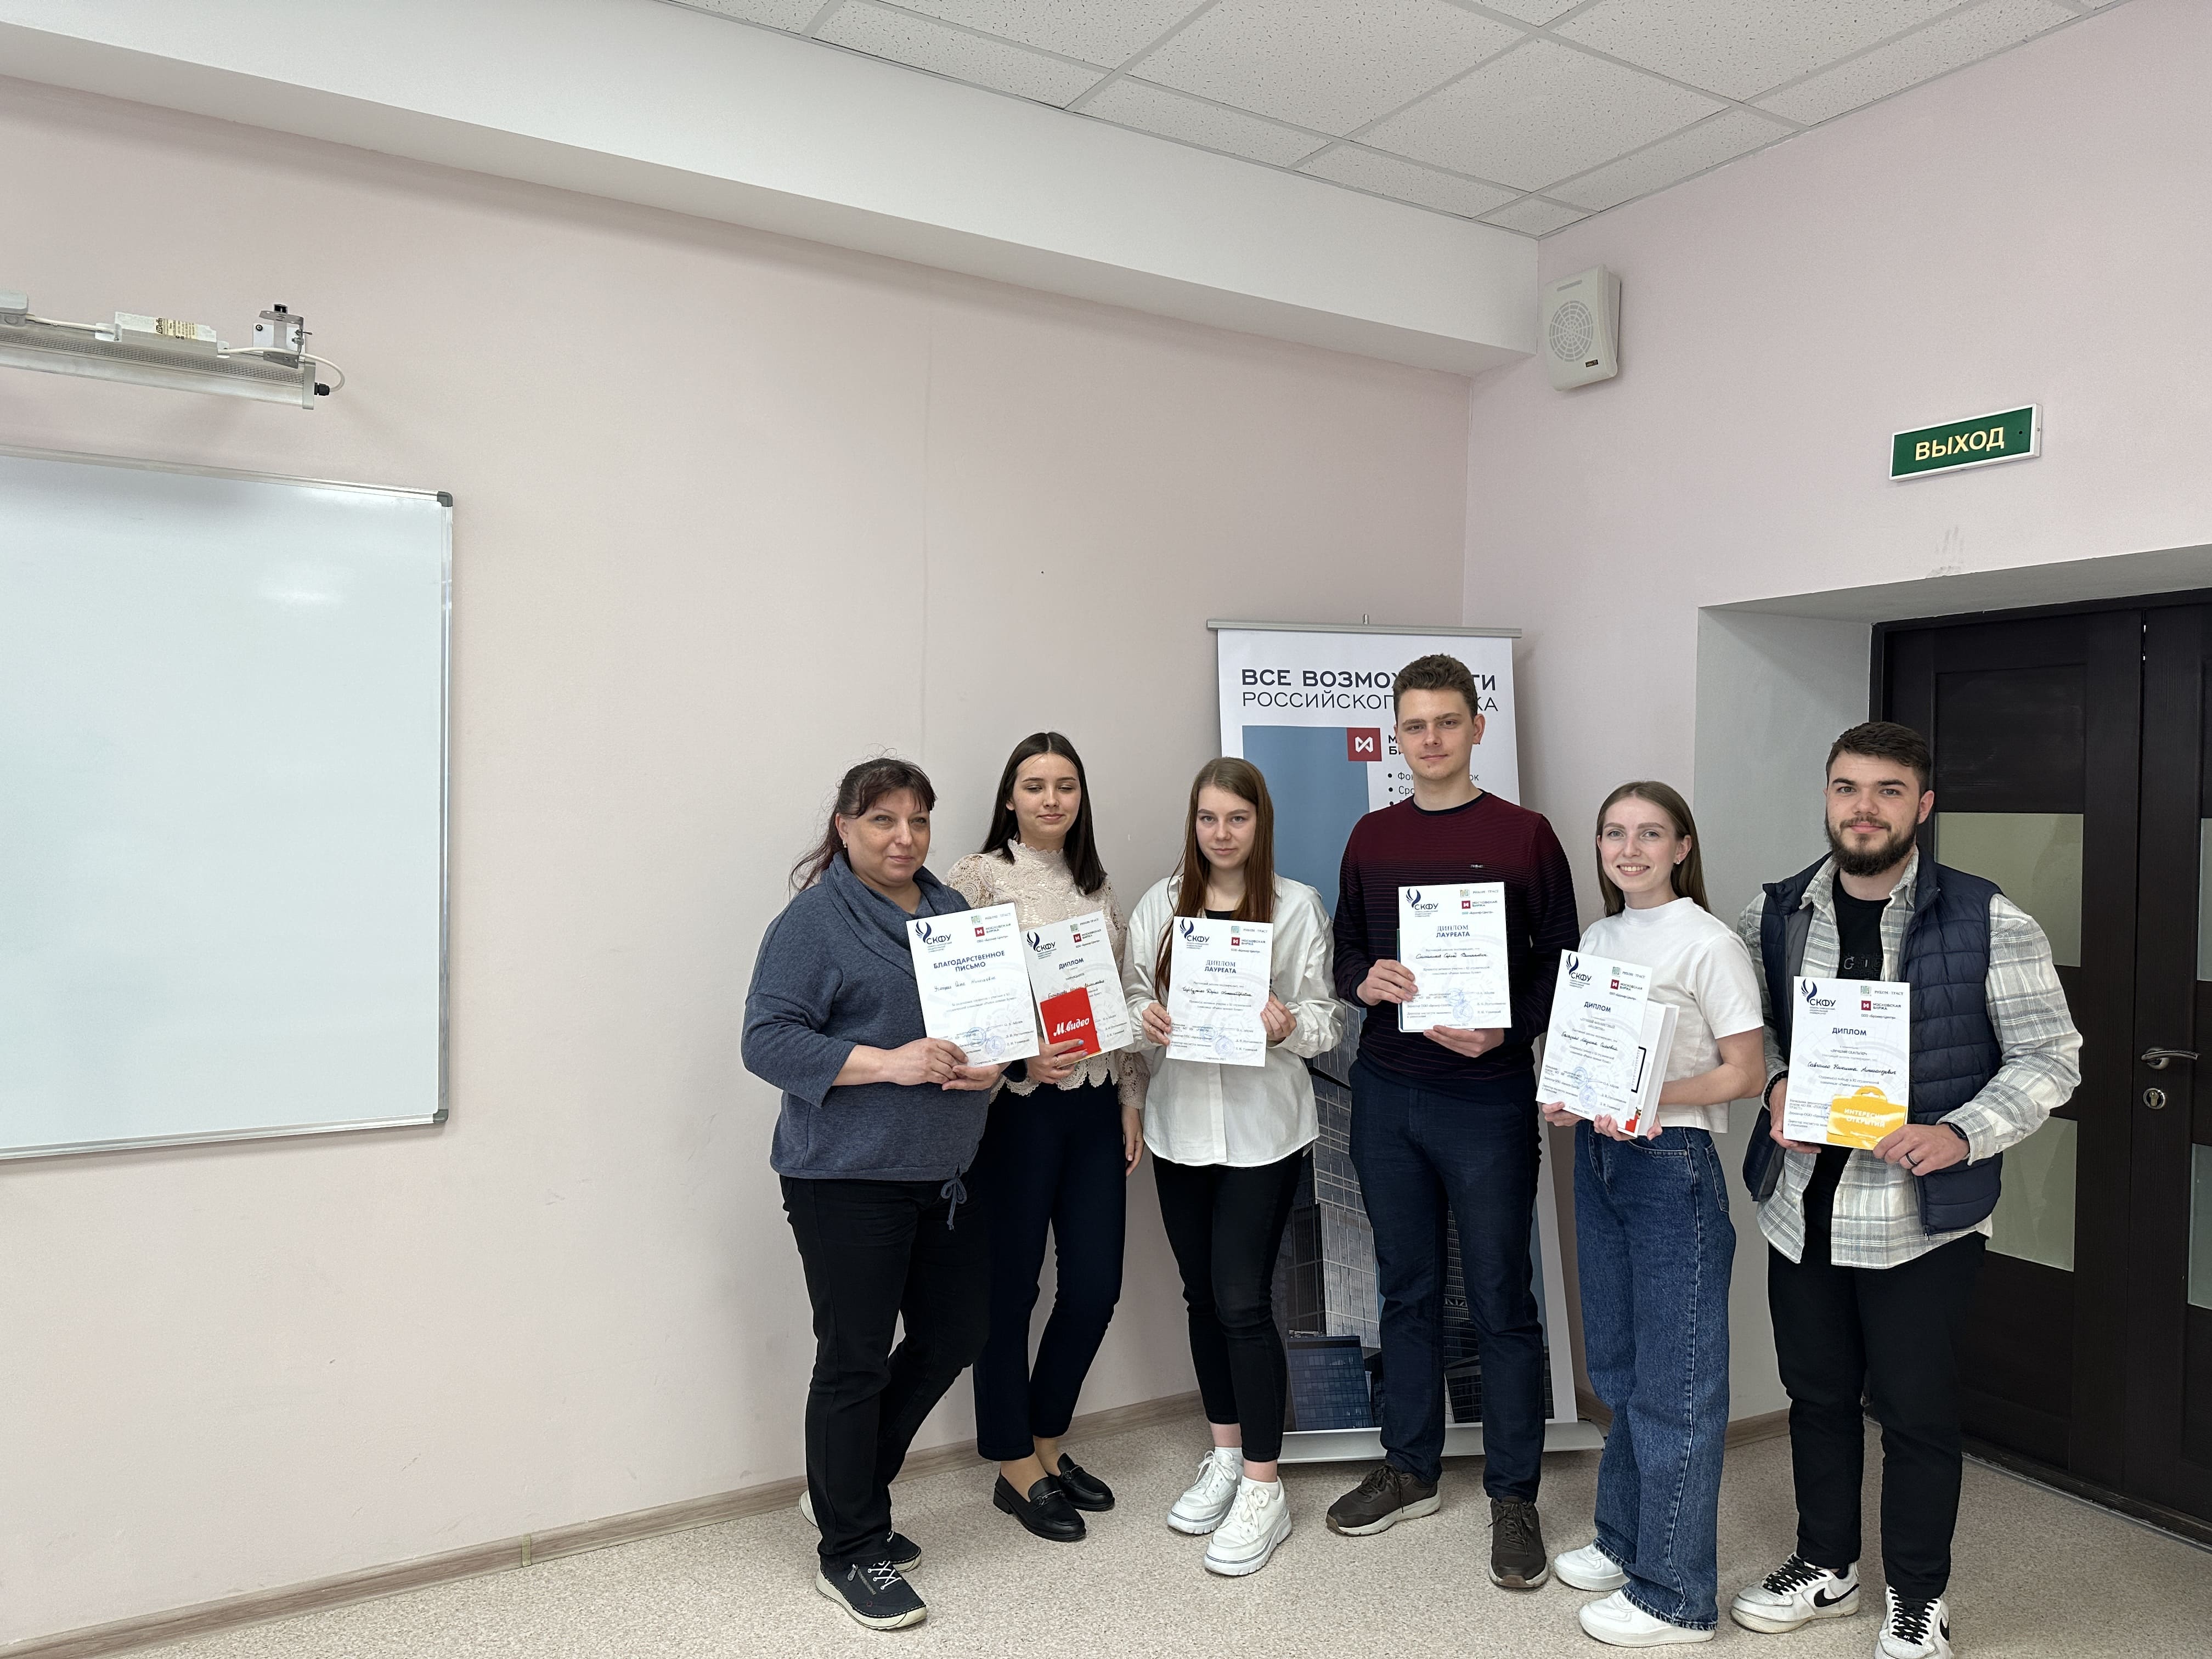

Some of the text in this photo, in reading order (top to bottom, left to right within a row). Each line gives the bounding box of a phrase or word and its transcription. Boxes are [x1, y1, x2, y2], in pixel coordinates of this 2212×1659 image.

[1915, 427, 2005, 461] ВЫХОД
[1242, 669, 1291, 686] ВСЕ
[1243, 690, 1394, 709] РОССИЙСКОГ
[926, 934, 952, 945] СКФУ
[1036, 941, 1056, 953] СКФУ
[933, 950, 1005, 969] БЛАГОДАРСТВЕННОЕ
[1059, 957, 1084, 970] ДИПЛОМ
[955, 961, 986, 972] ПИСЬМО
[1571, 971, 1592, 982] СКФУ
[1584, 1001, 1611, 1013] ДИПЛОМ
[1809, 998, 1836, 1007] СКФУ
[1053, 1018, 1090, 1036] М.видео
[1832, 1027, 1867, 1036] ДИПЛОМ
[1844, 1108, 1891, 1121] ИНТЕРЕСН
[1846, 1116, 1886, 1128] ОТКРЫТИЯ
